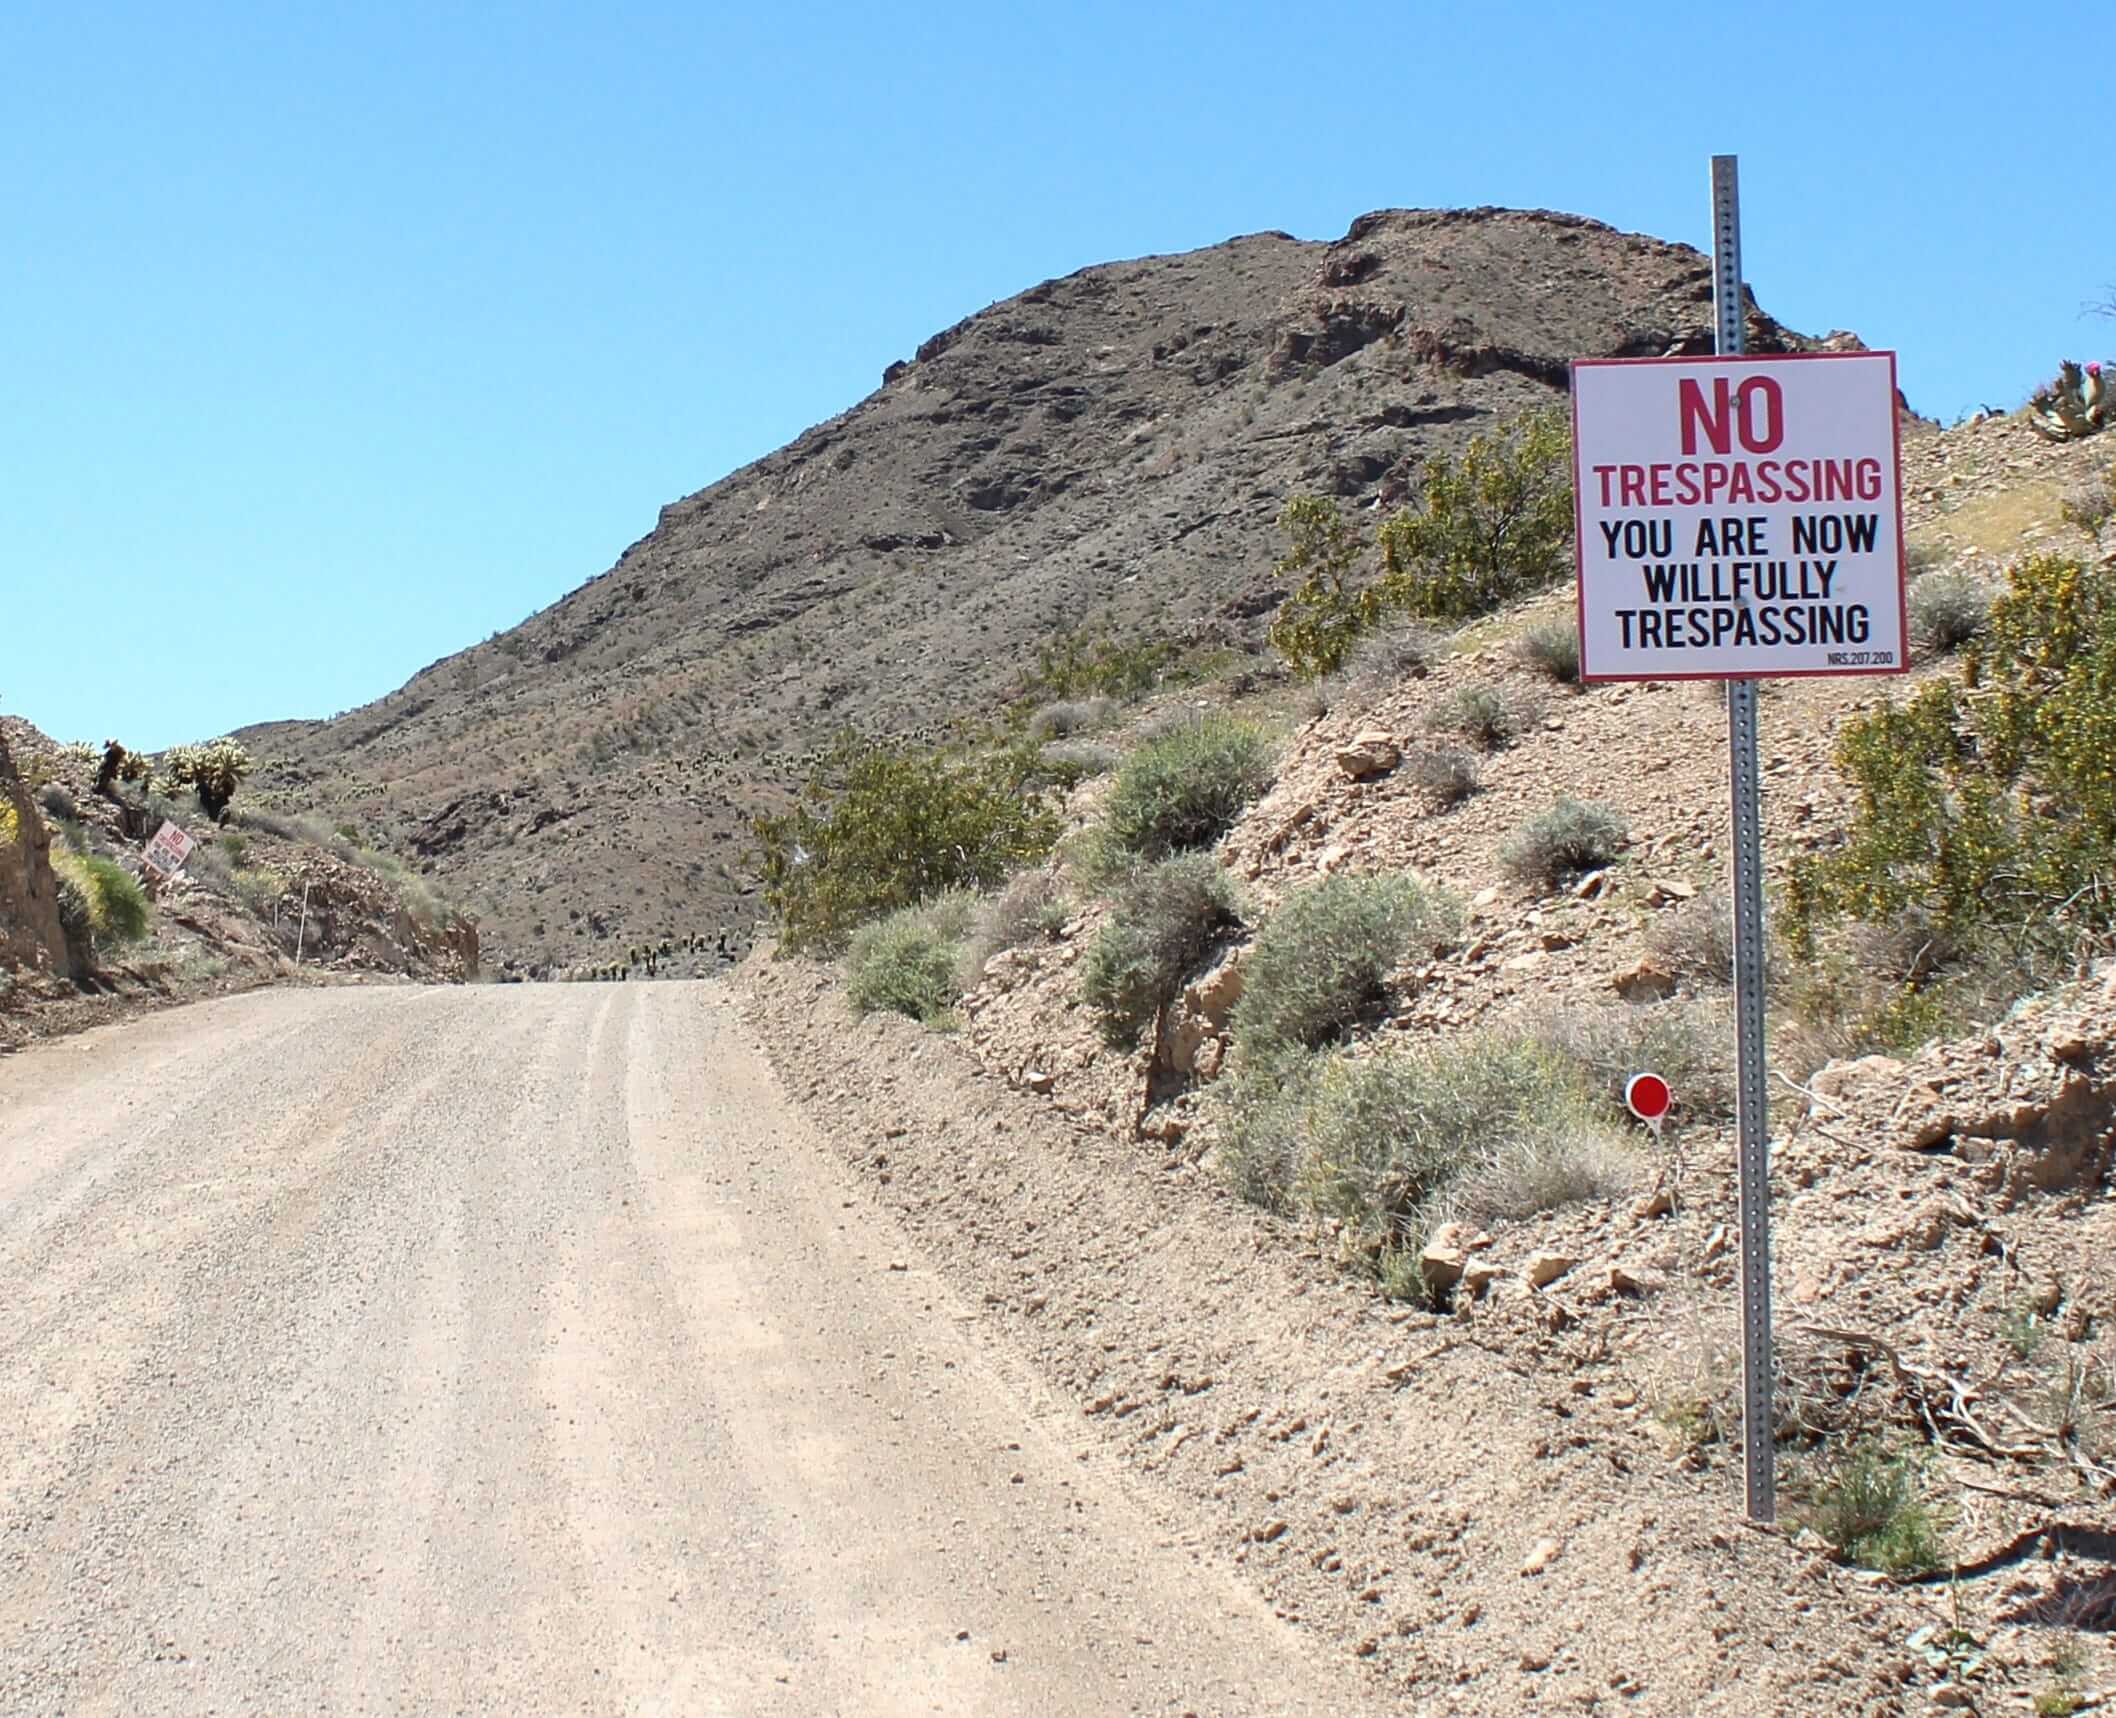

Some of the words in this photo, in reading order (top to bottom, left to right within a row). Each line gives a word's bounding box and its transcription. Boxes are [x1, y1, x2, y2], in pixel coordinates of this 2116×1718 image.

[1679, 376, 1784, 455] NO
[1592, 458, 1882, 507] TRESPASSING
[1599, 519, 1672, 559] YOU
[1695, 516, 1768, 556] ARE
[1792, 514, 1879, 554] NOW
[1643, 560, 1837, 603] WILLFULLY
[1615, 604, 1871, 649] TRESPASSING
[1827, 651, 1893, 666] NRS.207.200
